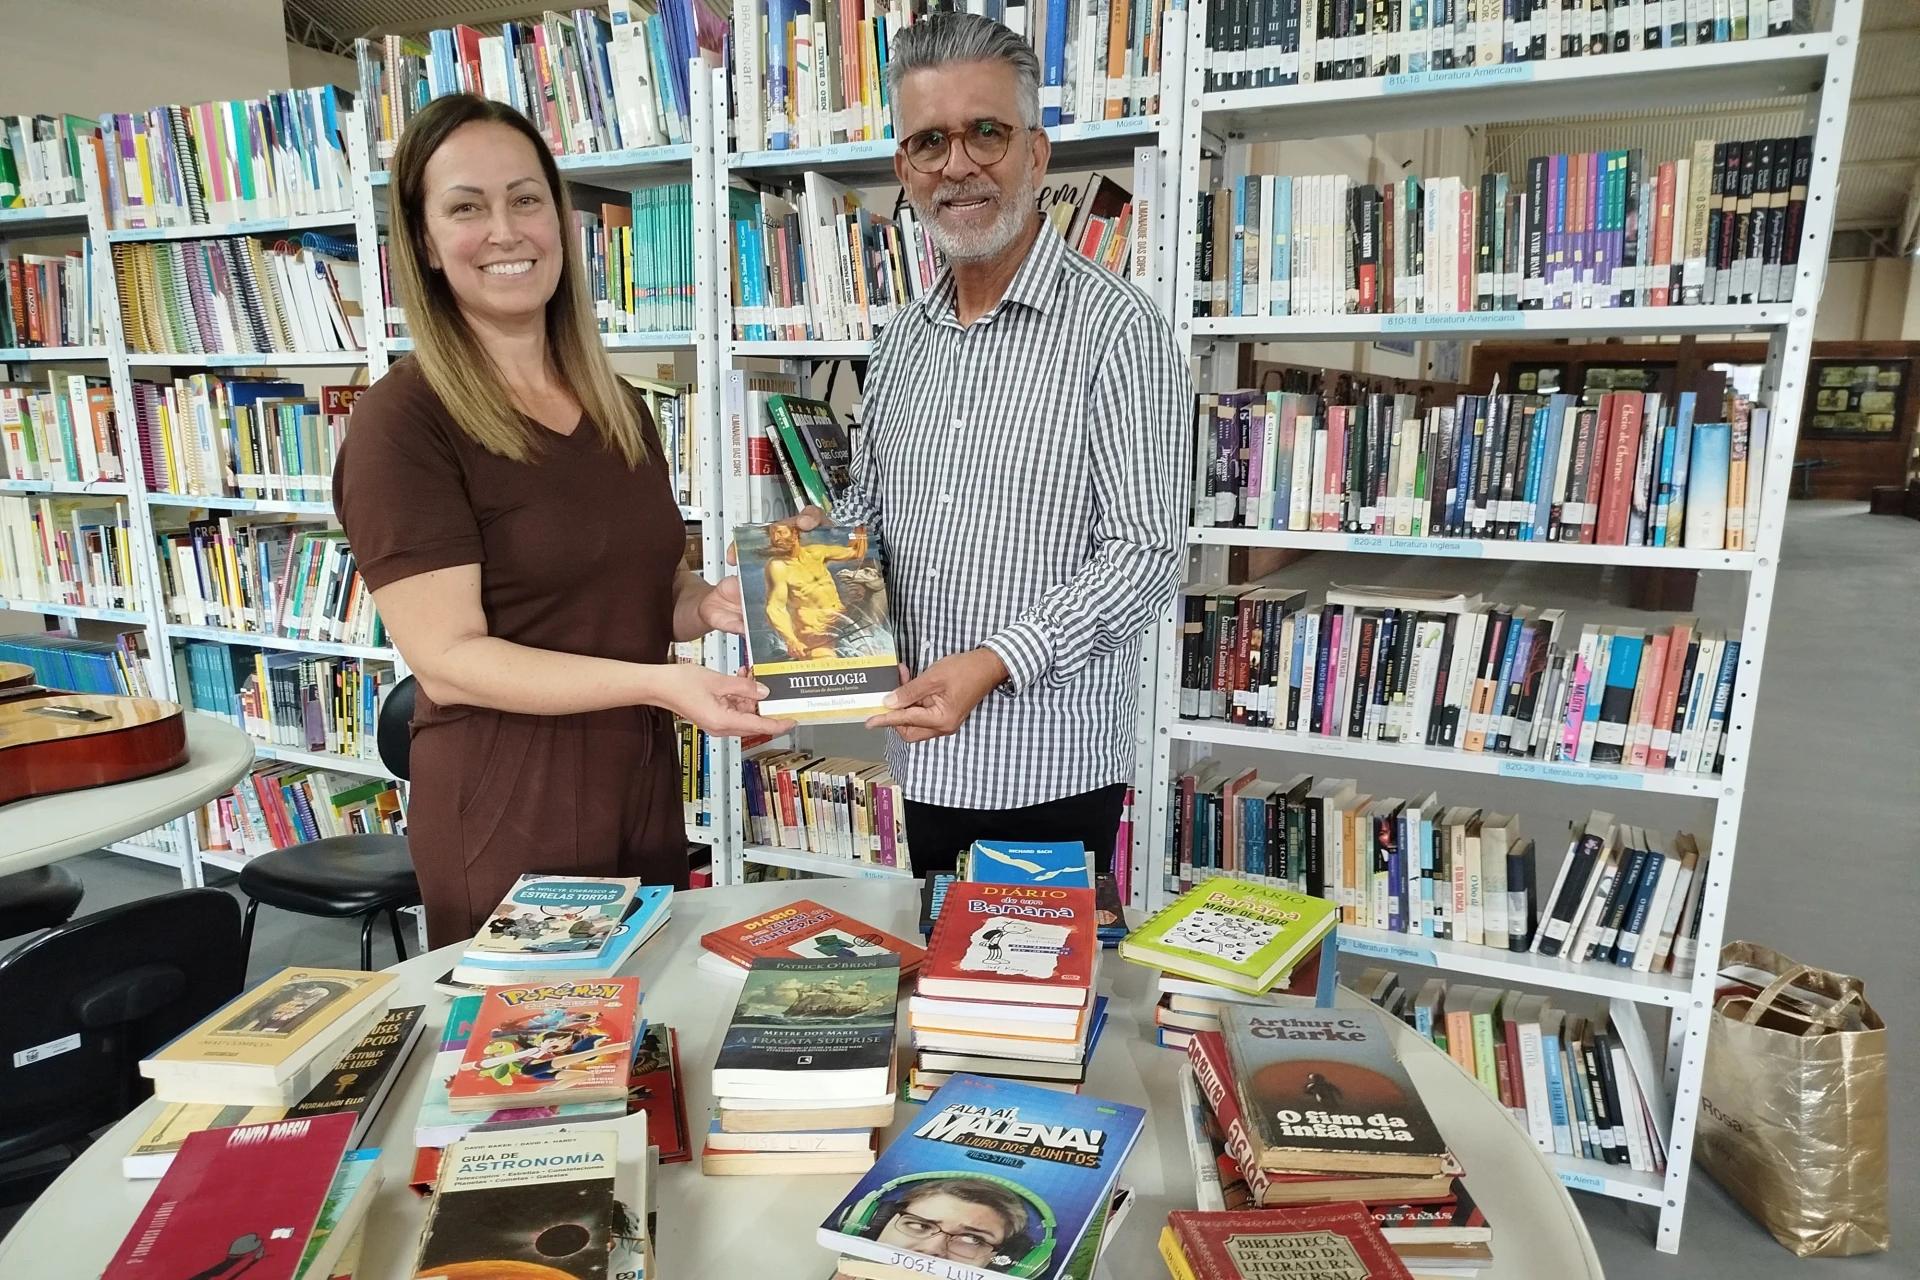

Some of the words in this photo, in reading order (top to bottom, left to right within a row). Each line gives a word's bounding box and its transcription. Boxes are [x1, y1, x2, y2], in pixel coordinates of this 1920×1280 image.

[1428, 70, 1471, 82] Literatura
[1473, 65, 1522, 77] Americana
[1087, 123, 1101, 131] 780
[1116, 119, 1143, 129] Música
[1138, 199, 1149, 239] ALMANAQUE
[1138, 240, 1147, 254] DAS
[1136, 254, 1147, 277] COPAS
[1425, 314, 1465, 325] Literatura
[1467, 313, 1515, 323] Americana
[1621, 403, 1635, 428] Cheio
[731, 413, 741, 448] ALMANAQUE
[1579, 413, 1592, 440] SIDNEY
[1619, 429, 1630, 442] de
[815, 438, 822, 449] O
[821, 449, 832, 460] nas
[1575, 441, 1587, 476] SHELDON
[1613, 444, 1629, 481] Charme
[733, 459, 742, 477] COPAS
[1462, 460, 1470, 478] ANOS
[1354, 538, 1382, 546] 820-28
[1389, 540, 1428, 549] Literatura
[1429, 542, 1461, 551] Inglesa
[1221, 615, 1231, 645] Cruzando
[1242, 607, 1251, 638] Samantha
[1363, 623, 1373, 647] SIDNEY
[1240, 638, 1249, 658] Young
[1218, 651, 1227, 677] Caminho
[1319, 661, 1327, 680] ANOS
[1359, 647, 1371, 678] SHELDON
[789, 671, 868, 689] MITOLOGIA
[1316, 682, 1325, 706] DEPOIS
[1570, 684, 1585, 713] MALDITA
[1543, 767, 1584, 779] Literatura
[1586, 770, 1618, 781] Inglesa
[1279, 797, 1287, 811] Scott
[1279, 811, 1287, 830] Walter
[1455, 872, 1465, 883] DIA
[519, 890, 575, 901] ESTRELAS
[576, 892, 617, 901] TORTAS
[982, 886, 1067, 899] DIÁRIO
[1000, 896, 1018, 904] de
[1020, 898, 1044, 906] um
[968, 899, 1075, 919] Banana
[1206, 890, 1301, 922] Banana
[1454, 892, 1464, 914] CHACAL
[744, 908, 798, 931] DIÁRIO
[767, 912, 809, 931] ZUMBI
[1238, 909, 1254, 918] DE
[1255, 914, 1289, 927] AZAR
[751, 912, 834, 947] MINECRAFT
[1352, 940, 1390, 953] Literatura
[1390, 946, 1418, 957] Inglesa
[776, 962, 823, 970] PATRICK
[826, 961, 878, 970] O'BRIAN
[1249, 1016, 1335, 1030] Arthur
[1337, 1020, 1361, 1030] C.
[736, 1035, 748, 1044] A
[751, 1036, 812, 1045] FRAGATA
[816, 1035, 882, 1044] SURPRISE
[1251, 1026, 1367, 1043] Clarke
[350, 1058, 379, 1070] LUZES
[344, 1095, 366, 1106] ELLIS
[944, 1103, 990, 1117] FALA
[1277, 1109, 1303, 1124] O
[1304, 1111, 1364, 1127] fim
[1366, 1113, 1408, 1128] da
[1701, 1095, 1743, 1133] Rosa
[226, 1123, 270, 1147] CONTO
[267, 1119, 312, 1141] POESIA
[913, 1112, 1104, 1153] MALENA!
[1280, 1122, 1415, 1143] infância
[458, 1152, 606, 1174] ASTRONOMÍA
[461, 1152, 495, 1163] GUÍA
[500, 1152, 520, 1161] DE
[1000, 1143, 1026, 1154] DOS
[1030, 1146, 1098, 1167] BUNITOS
[1573, 1175, 1600, 1187] Alemã
[1236, 1235, 1339, 1249] BIBLIOTECA
[1239, 1251, 1263, 1261] DE
[1265, 1250, 1319, 1262] OURO
[1321, 1248, 1348, 1259] DA
[890, 1251, 937, 1275] JOSÉ
[946, 1265, 986, 1280] LUIZ
[1242, 1260, 1355, 1273] LITERATURA
[1255, 1267, 1358, 1280] UNIVERSAL
